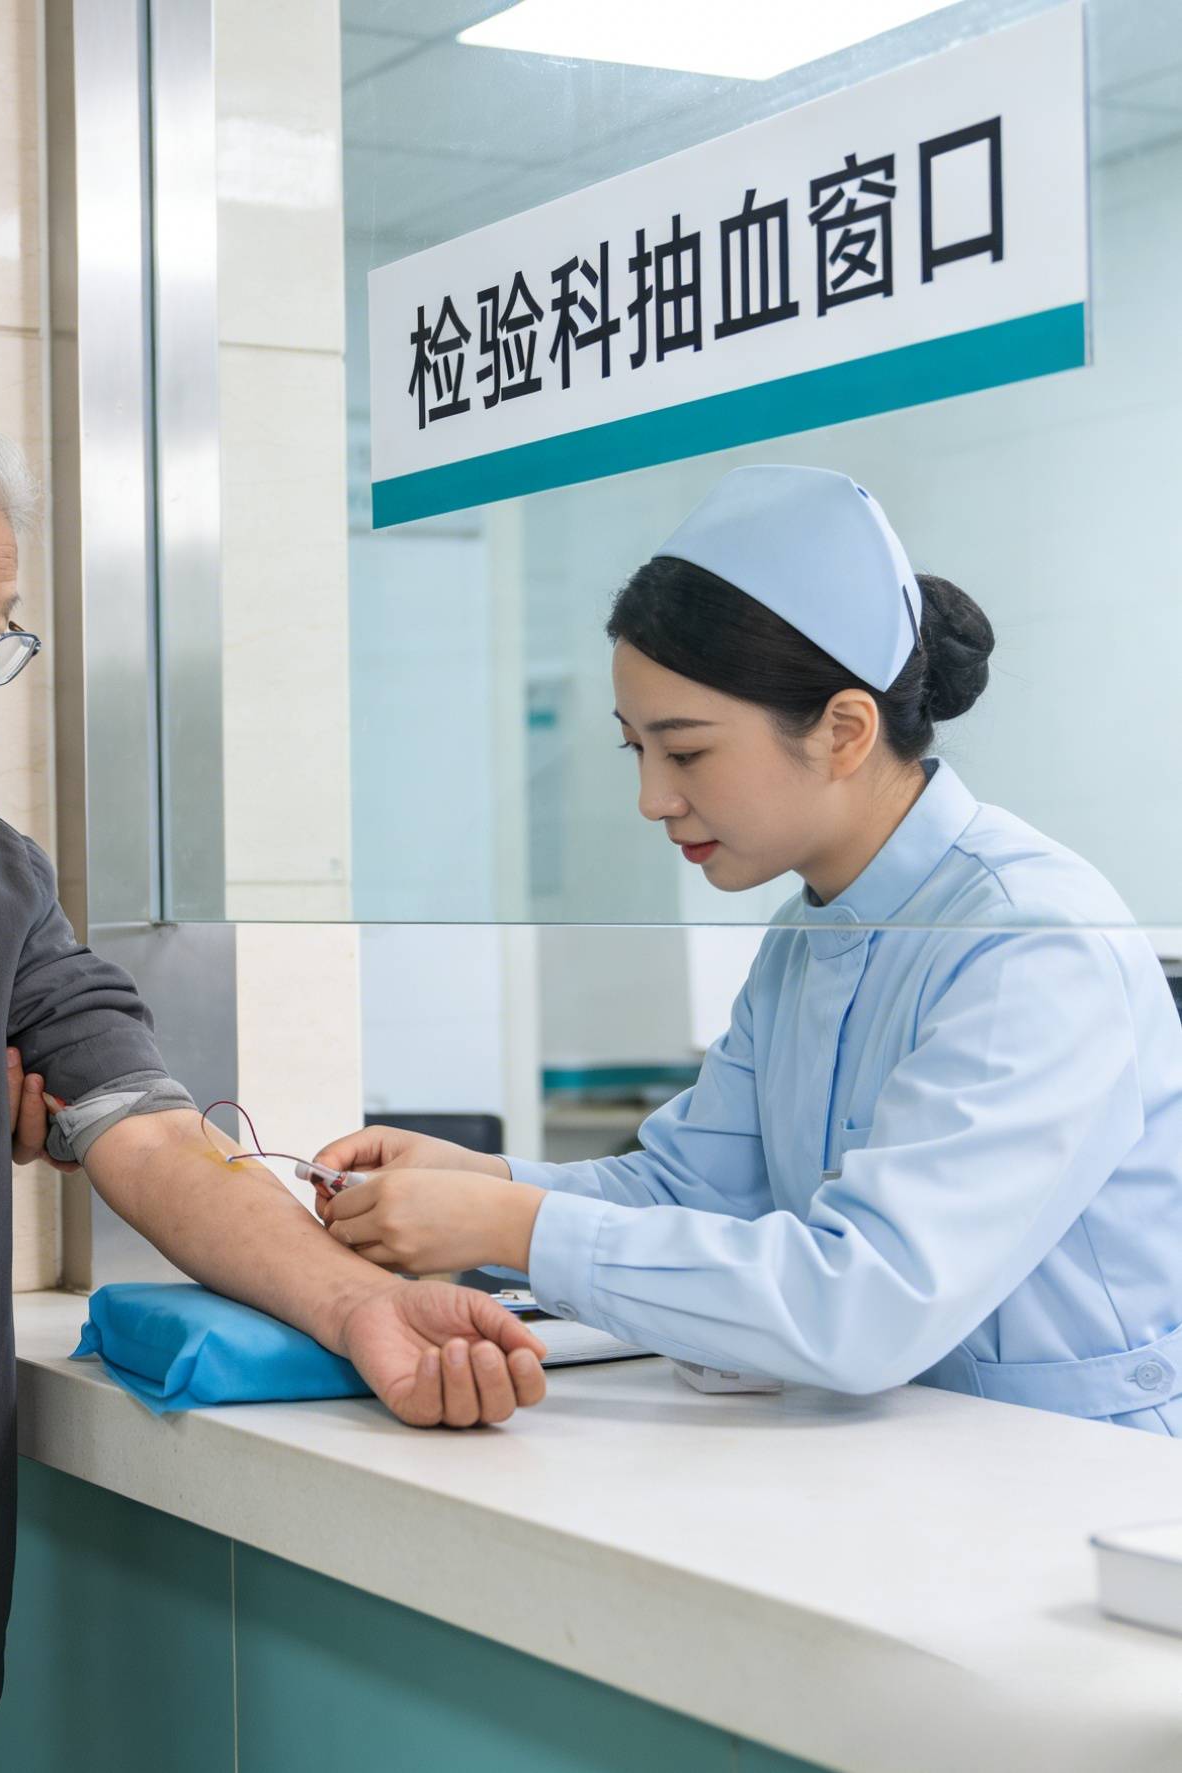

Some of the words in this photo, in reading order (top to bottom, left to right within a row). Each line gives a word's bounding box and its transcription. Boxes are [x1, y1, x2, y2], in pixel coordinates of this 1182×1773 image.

[408, 115, 1005, 431] 检验科抽血窗口
